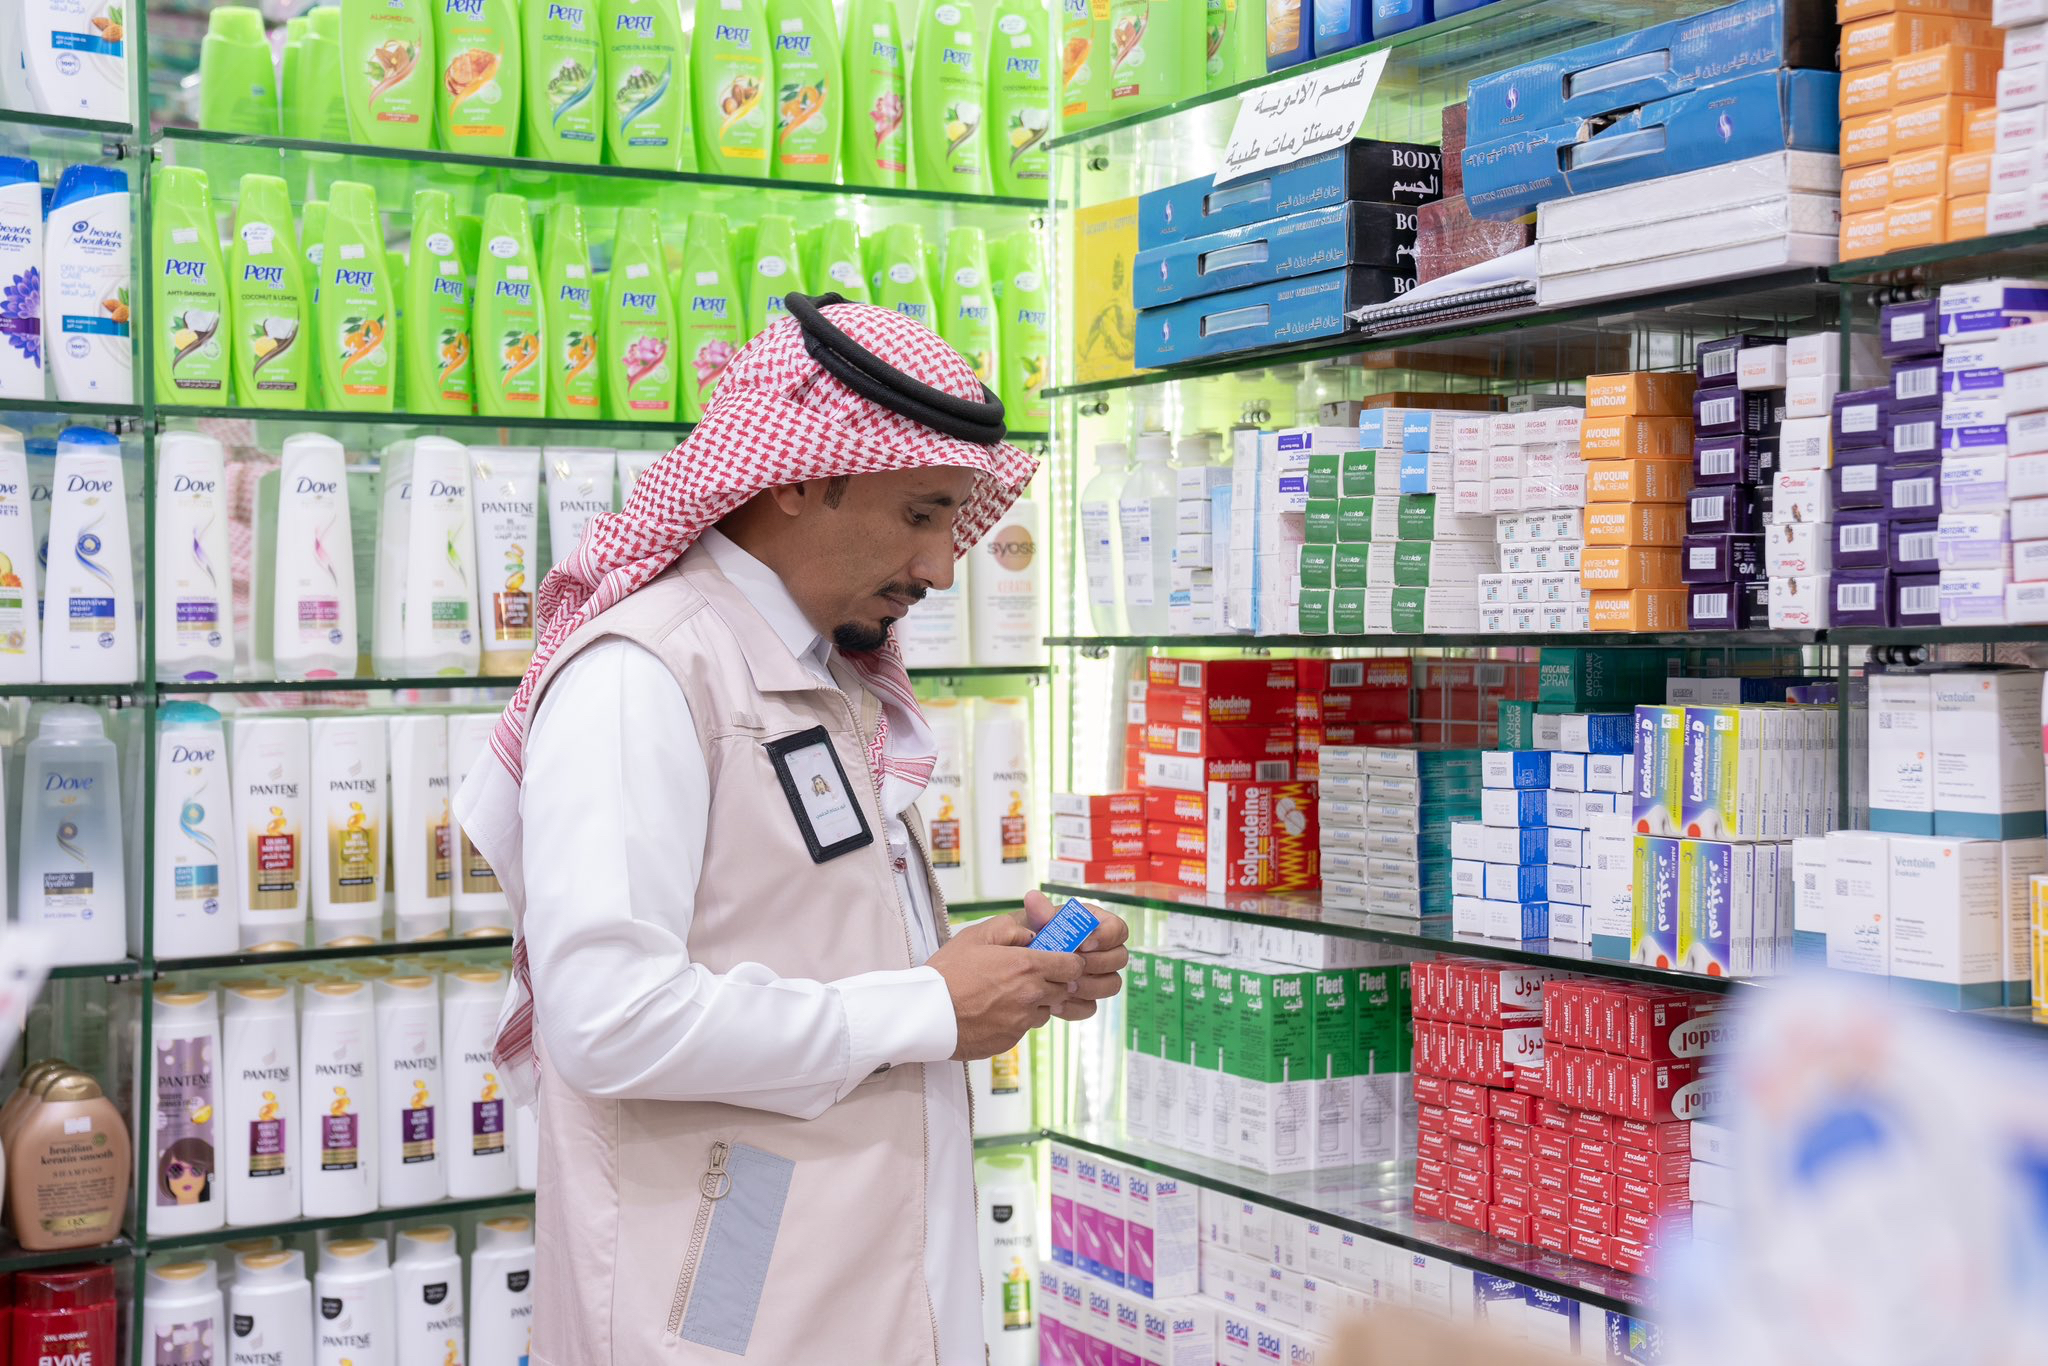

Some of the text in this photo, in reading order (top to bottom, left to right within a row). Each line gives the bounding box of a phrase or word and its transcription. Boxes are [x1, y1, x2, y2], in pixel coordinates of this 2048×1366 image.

[1254, 60, 1368, 118] قسم الأدوية
[1225, 120, 1355, 172] ومستلزمات طبية
[1392, 149, 1442, 171] BODY
[1894, 161, 1937, 177] AVOQUIN
[1392, 174, 1439, 200] الجسم
[1395, 213, 1418, 231] BO
[89, 229, 116, 239] head
[1847, 223, 1884, 237] AVOQUIN
[73, 236, 122, 248] shoulders
[1394, 277, 1418, 294] BO
[1591, 387, 1614, 395] CREAM
[1591, 395, 1627, 407] AVOQUIN
[1586, 428, 1620, 438] AVOQUIN
[1598, 440, 1620, 448] CREAM
[1593, 471, 1629, 481] AVOQUIN
[0, 483, 17, 494] ove
[67, 474, 113, 493] Dove
[174, 474, 215, 493] Dove
[297, 477, 337, 494] Dove
[430, 480, 465, 496] Dove
[1593, 482, 1629, 491] 4% CREAM
[482, 502, 534, 514] PANTENE
[560, 501, 611, 513] PANTENE
[1590, 514, 1625, 525] AVOQUIN
[1603, 526, 1625, 534] CREAM
[987, 538, 1036, 558] syoss
[1584, 559, 1607, 567] CREAM
[1584, 569, 1619, 579] AVOQUIN
[1595, 601, 1630, 610] AVOQUIN
[1541, 665, 1570, 675] AVOCAINE
[1594, 652, 1603, 697] SPRAY
[1367, 672, 1408, 687] Solpadeine
[1541, 673, 1570, 688] SPRAY
[1209, 695, 1251, 713] Solpadeine
[1936, 691, 1976, 703] Ventolin
[1505, 704, 1514, 749] SPRAY
[172, 745, 215, 763] Dove
[1209, 760, 1251, 778] Solpadeine
[46, 772, 93, 791] Dove
[330, 780, 376, 792] PANTENE
[250, 784, 298, 796] PANTENE
[1259, 787, 1272, 835] SOLUBLE
[1238, 787, 1268, 886] Solpadeine
[1894, 856, 1936, 869] Ventolin
[45, 880, 75, 888] hydrate
[1155, 958, 1174, 979] Fleet
[1185, 965, 1204, 985] Fleet
[1212, 970, 1232, 990] Fleet
[1240, 975, 1261, 995] Fleet
[1316, 975, 1343, 995] Fleet
[1359, 972, 1386, 991] Fleet
[1273, 978, 1302, 998] Fleet
[1283, 997, 1303, 1010] فليت
[1326, 996, 1346, 1010] فليت
[394, 1057, 437, 1070] PANTENE
[465, 1053, 493, 1063] PANT
[243, 1067, 290, 1081] PANTENE
[315, 1063, 364, 1076] PANTENE
[158, 1073, 212, 1088] PANTENE
[1580, 1113, 1602, 1122] Fevadol
[1624, 1120, 1646, 1131] Fevadol
[49, 1145, 93, 1155] brazilian
[1581, 1143, 1603, 1152] Fevadol
[40, 1150, 114, 1165] keratin smooth
[1625, 1151, 1648, 1162] Fevadol
[52, 1166, 102, 1179] SHAMPOO
[1077, 1160, 1096, 1178] adol
[1101, 1168, 1120, 1187] adol
[1580, 1173, 1602, 1183] Fevadol
[1129, 1176, 1148, 1196] adol
[1156, 1180, 1177, 1193] adol
[1625, 1183, 1648, 1193] Fevadol
[1580, 1203, 1601, 1214] Fevadol
[1626, 1214, 1648, 1225] Fevadol
[1579, 1234, 1601, 1244] Fevadol
[1621, 1245, 1644, 1256] Fevadol
[1062, 1281, 1081, 1300] adol
[1089, 1292, 1110, 1311] adol
[1117, 1303, 1138, 1322] adol
[1145, 1313, 1166, 1332] adol
[1173, 1318, 1194, 1331] adol
[1225, 1320, 1249, 1339] adol
[59, 1331, 88, 1340] FORMAT
[322, 1333, 371, 1348] PANTENE
[1257, 1331, 1281, 1352] adol
